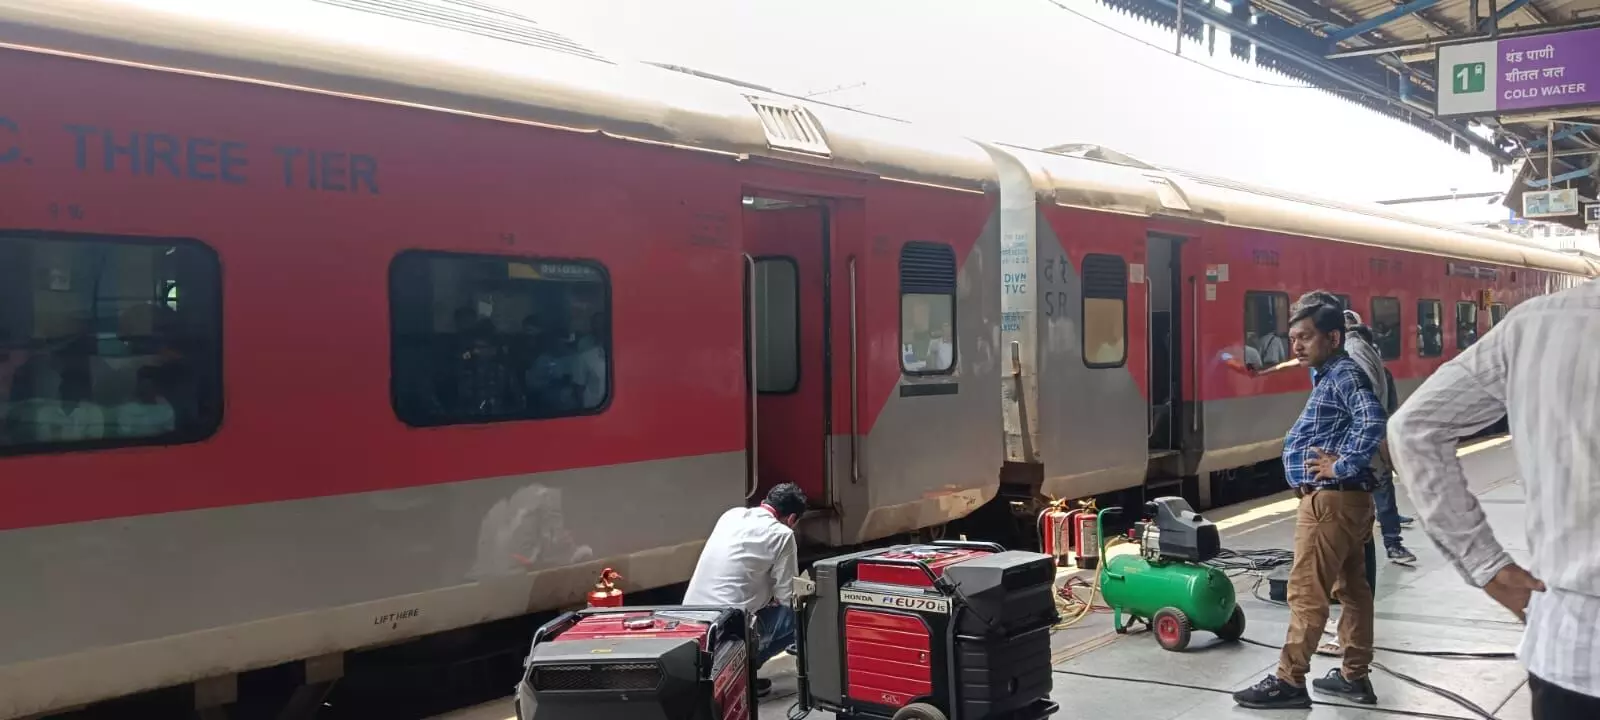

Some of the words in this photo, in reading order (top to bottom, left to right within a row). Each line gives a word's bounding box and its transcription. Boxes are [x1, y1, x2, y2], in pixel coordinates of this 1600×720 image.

[1456, 67, 1469, 91] 1
[1504, 68, 1539, 82] शीतल
[1542, 66, 1565, 78] जल
[1504, 88, 1538, 100] COLD
[1541, 83, 1586, 97] WATER
[62, 123, 248, 185] THREE
[272, 145, 381, 196] TIER
[1003, 285, 1026, 294] TVC
[844, 593, 873, 602] HONDA
